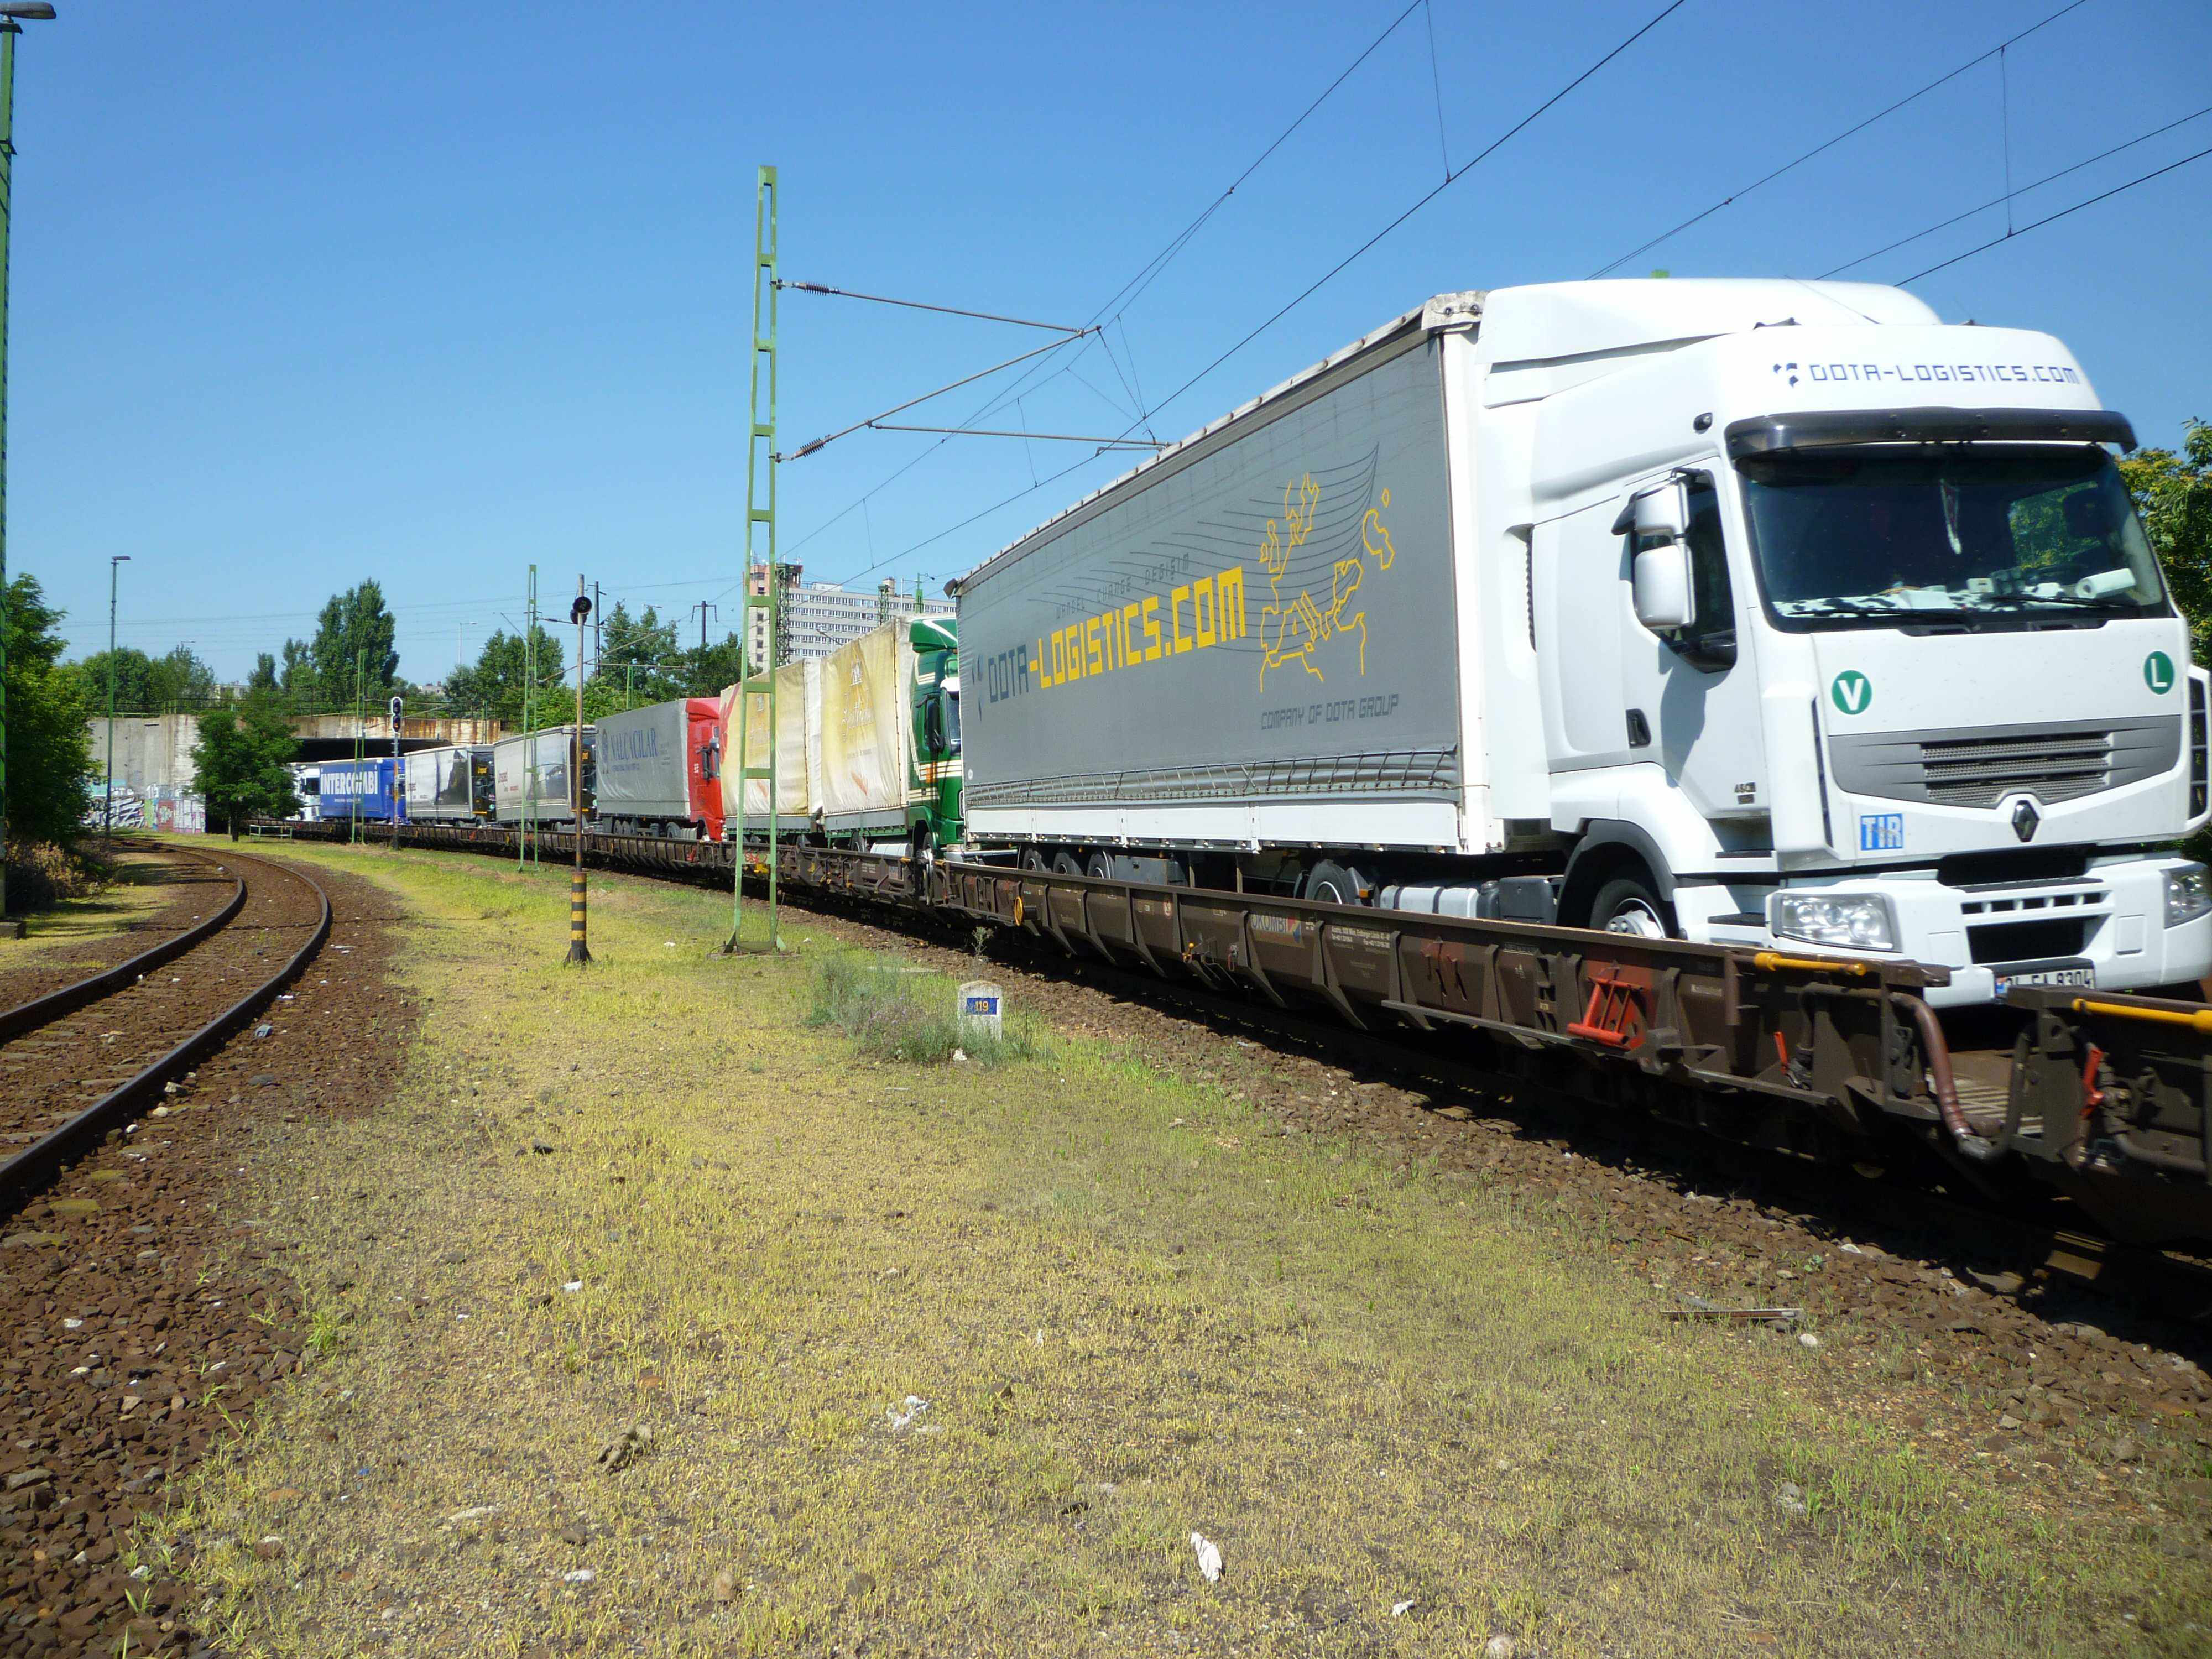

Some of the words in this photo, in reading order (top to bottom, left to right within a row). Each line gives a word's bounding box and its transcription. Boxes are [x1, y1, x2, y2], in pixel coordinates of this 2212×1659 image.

[2149, 658, 2168, 688] L
[1837, 677, 1865, 712] V
[1261, 706, 1305, 730] COMPANY
[1308, 703, 1323, 724] OF
[1326, 699, 1355, 723] DOTA
[1358, 693, 1399, 719] GROUP
[1861, 815, 1903, 848] TIR
[974, 1000, 989, 1012] 119
